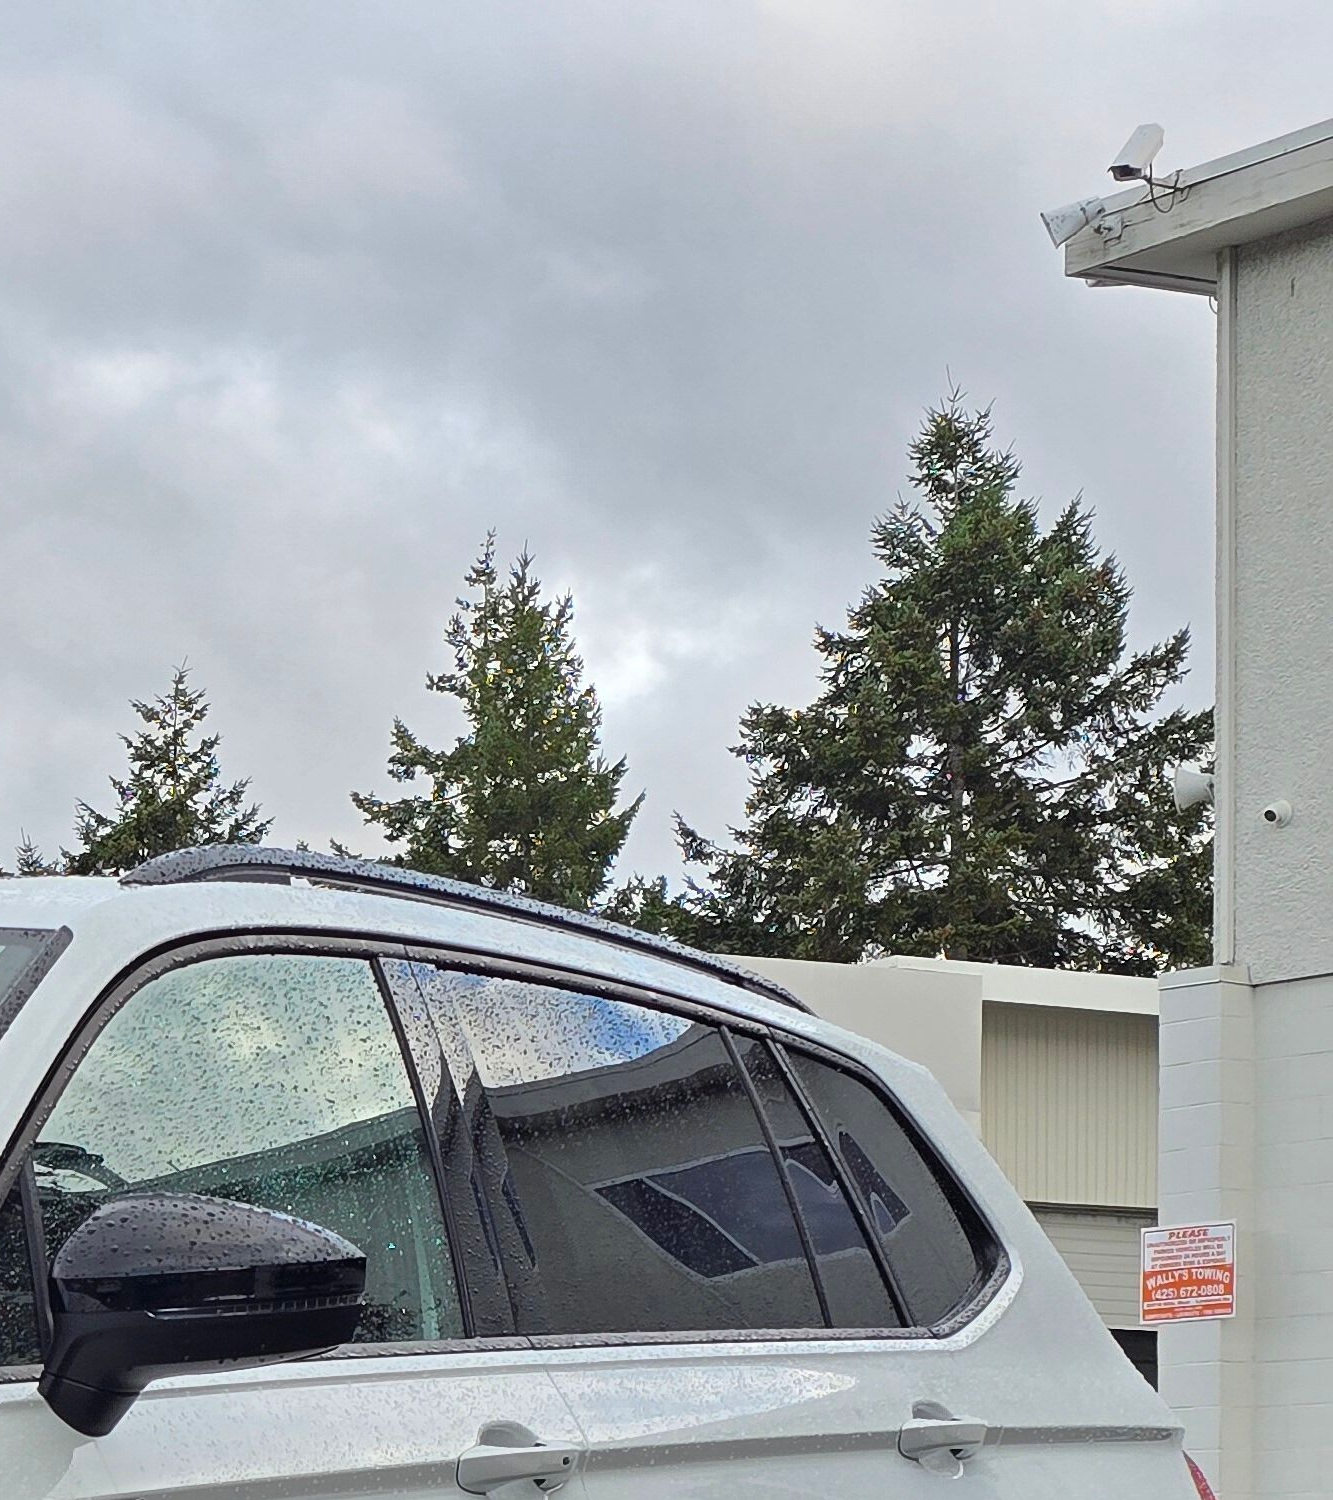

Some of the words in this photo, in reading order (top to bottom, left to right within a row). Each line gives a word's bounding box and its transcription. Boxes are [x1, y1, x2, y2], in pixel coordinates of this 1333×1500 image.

[1168, 1229, 1210, 1240] PLEASE
[1146, 1270, 1189, 1290] WALLY'S
[1191, 1269, 1230, 1283] TOWING
[1152, 1288, 1177, 1300] (425)
[1180, 1284, 1225, 1297] 672-0808
